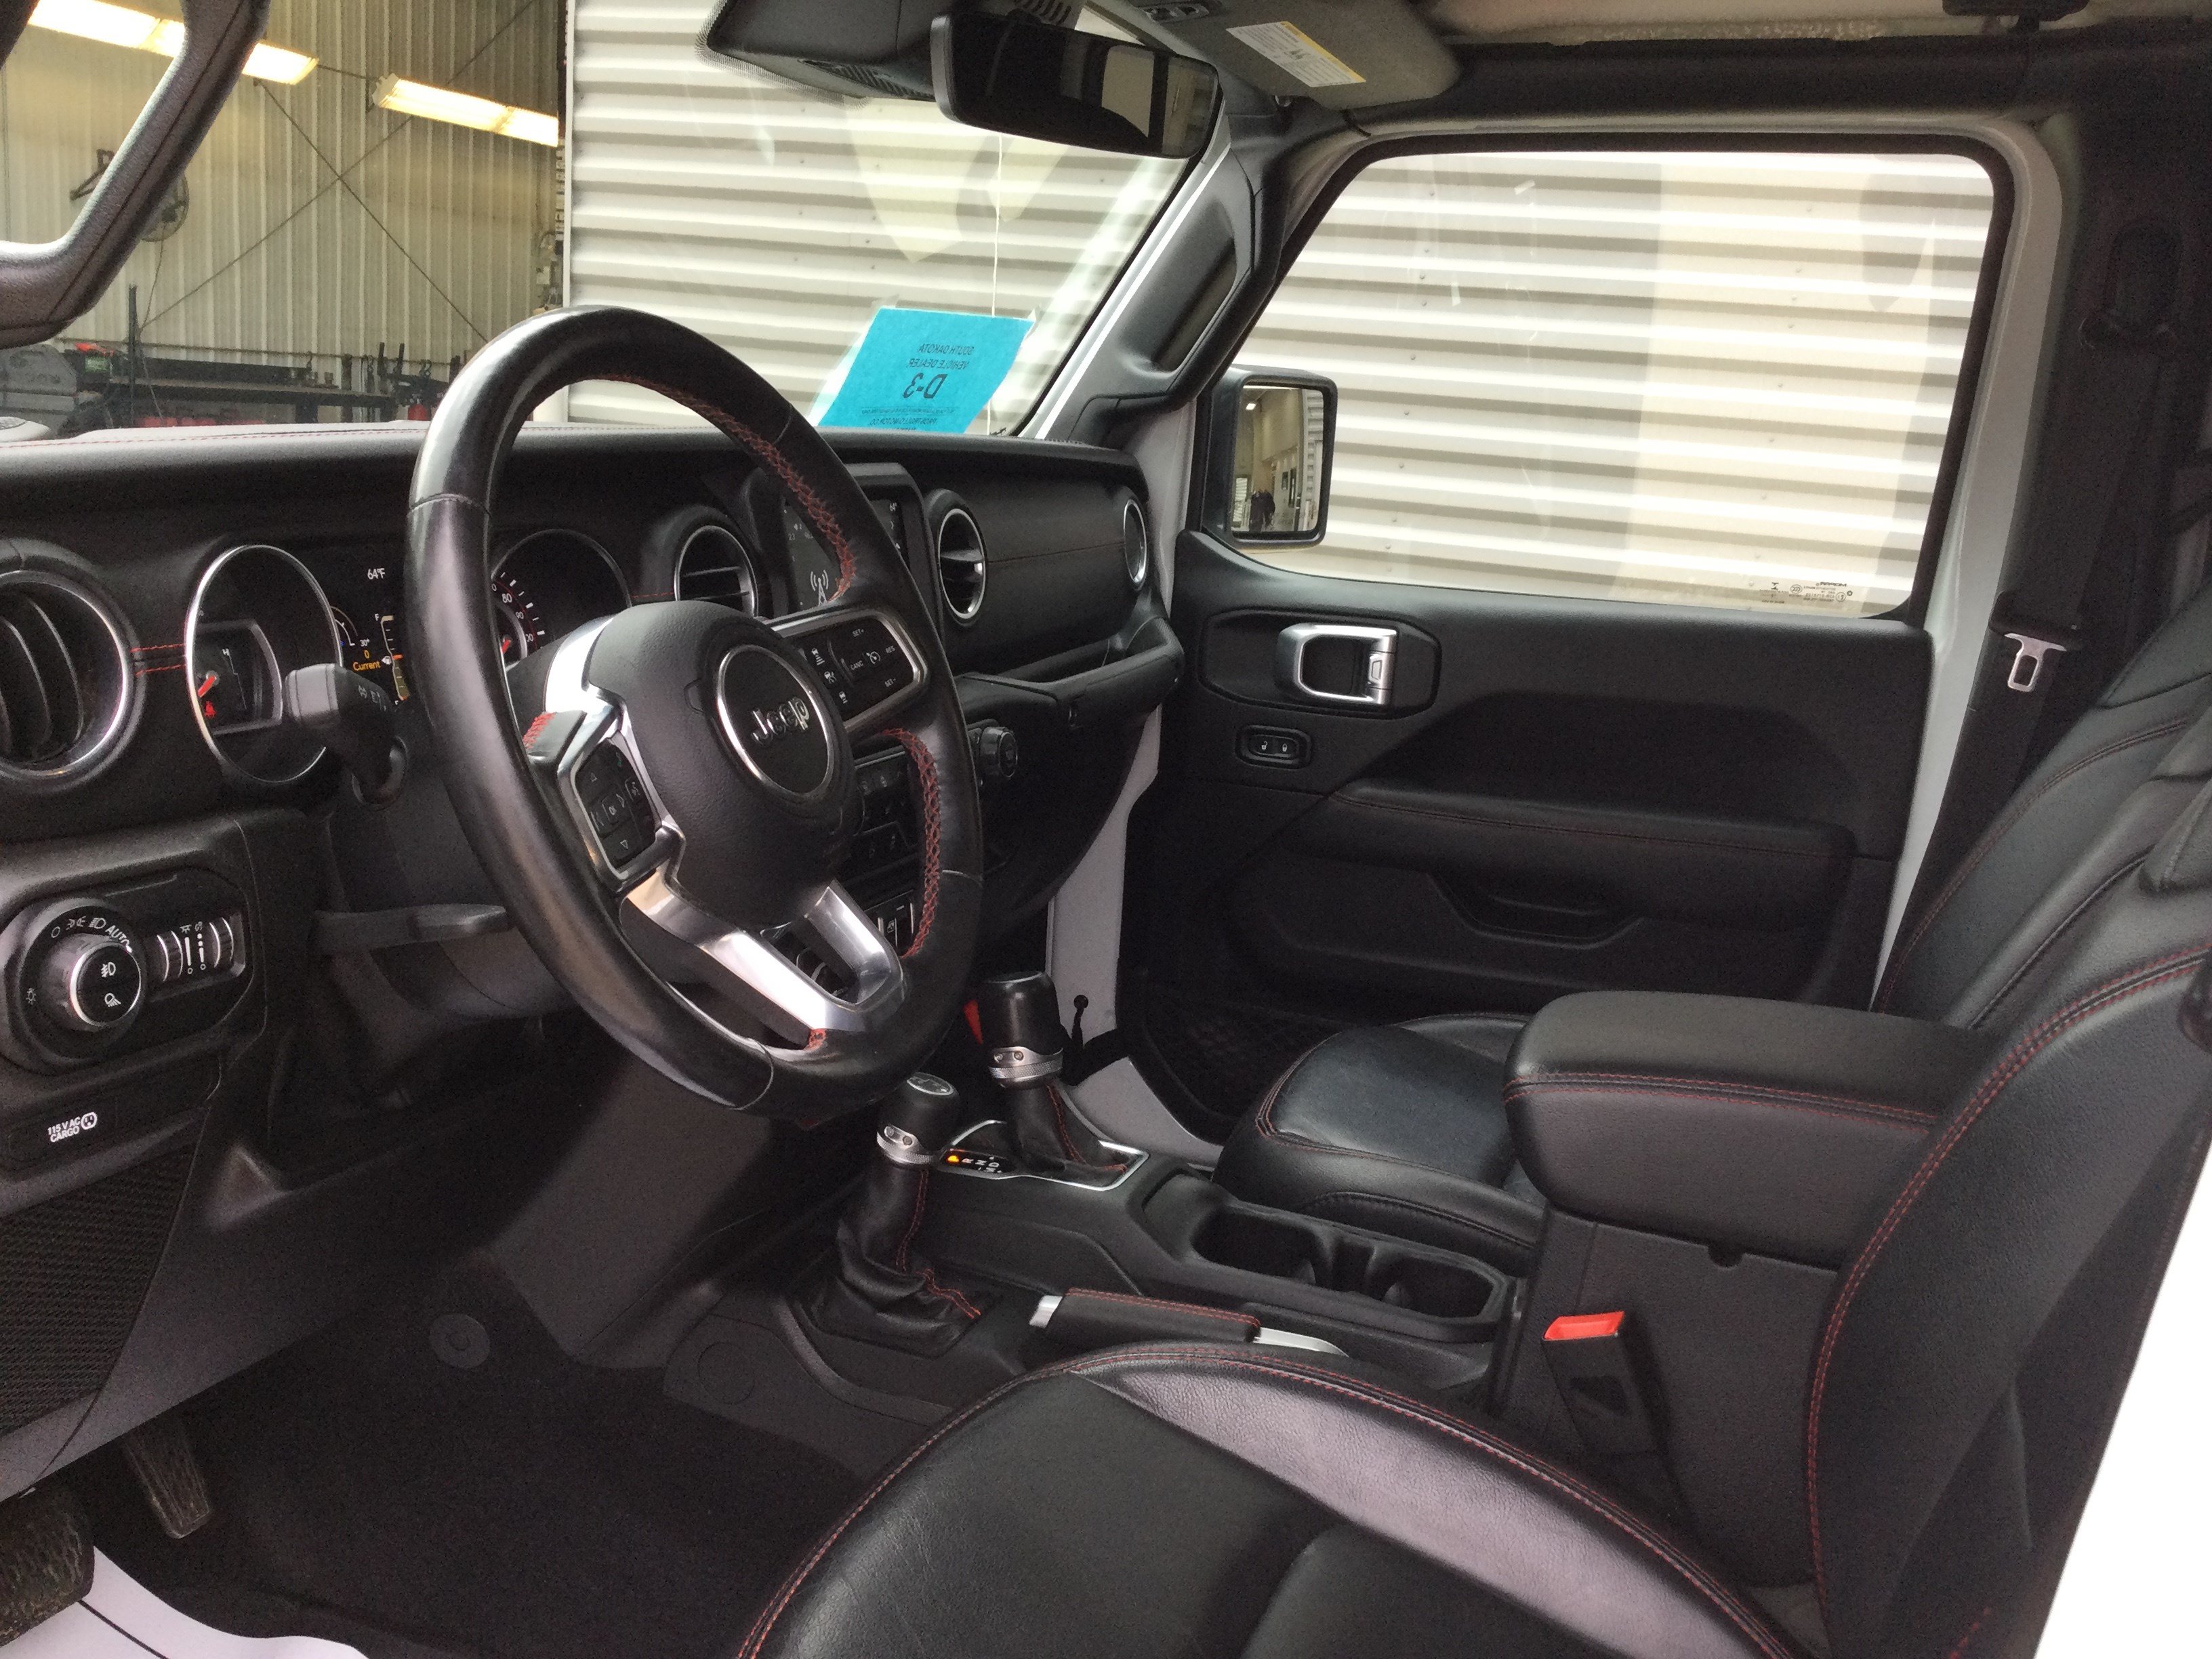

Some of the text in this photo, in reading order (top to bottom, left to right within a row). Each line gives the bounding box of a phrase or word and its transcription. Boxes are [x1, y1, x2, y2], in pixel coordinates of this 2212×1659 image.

[501, 593, 512, 604] 80
[515, 611, 524, 619] 90
[352, 661, 381, 672] Current
[750, 696, 811, 745] Jeep
[105, 924, 130, 947] AUTO
[47, 1123, 61, 1136] 115
[69, 1116, 81, 1128] AC
[50, 1125, 80, 1143] CARGO
